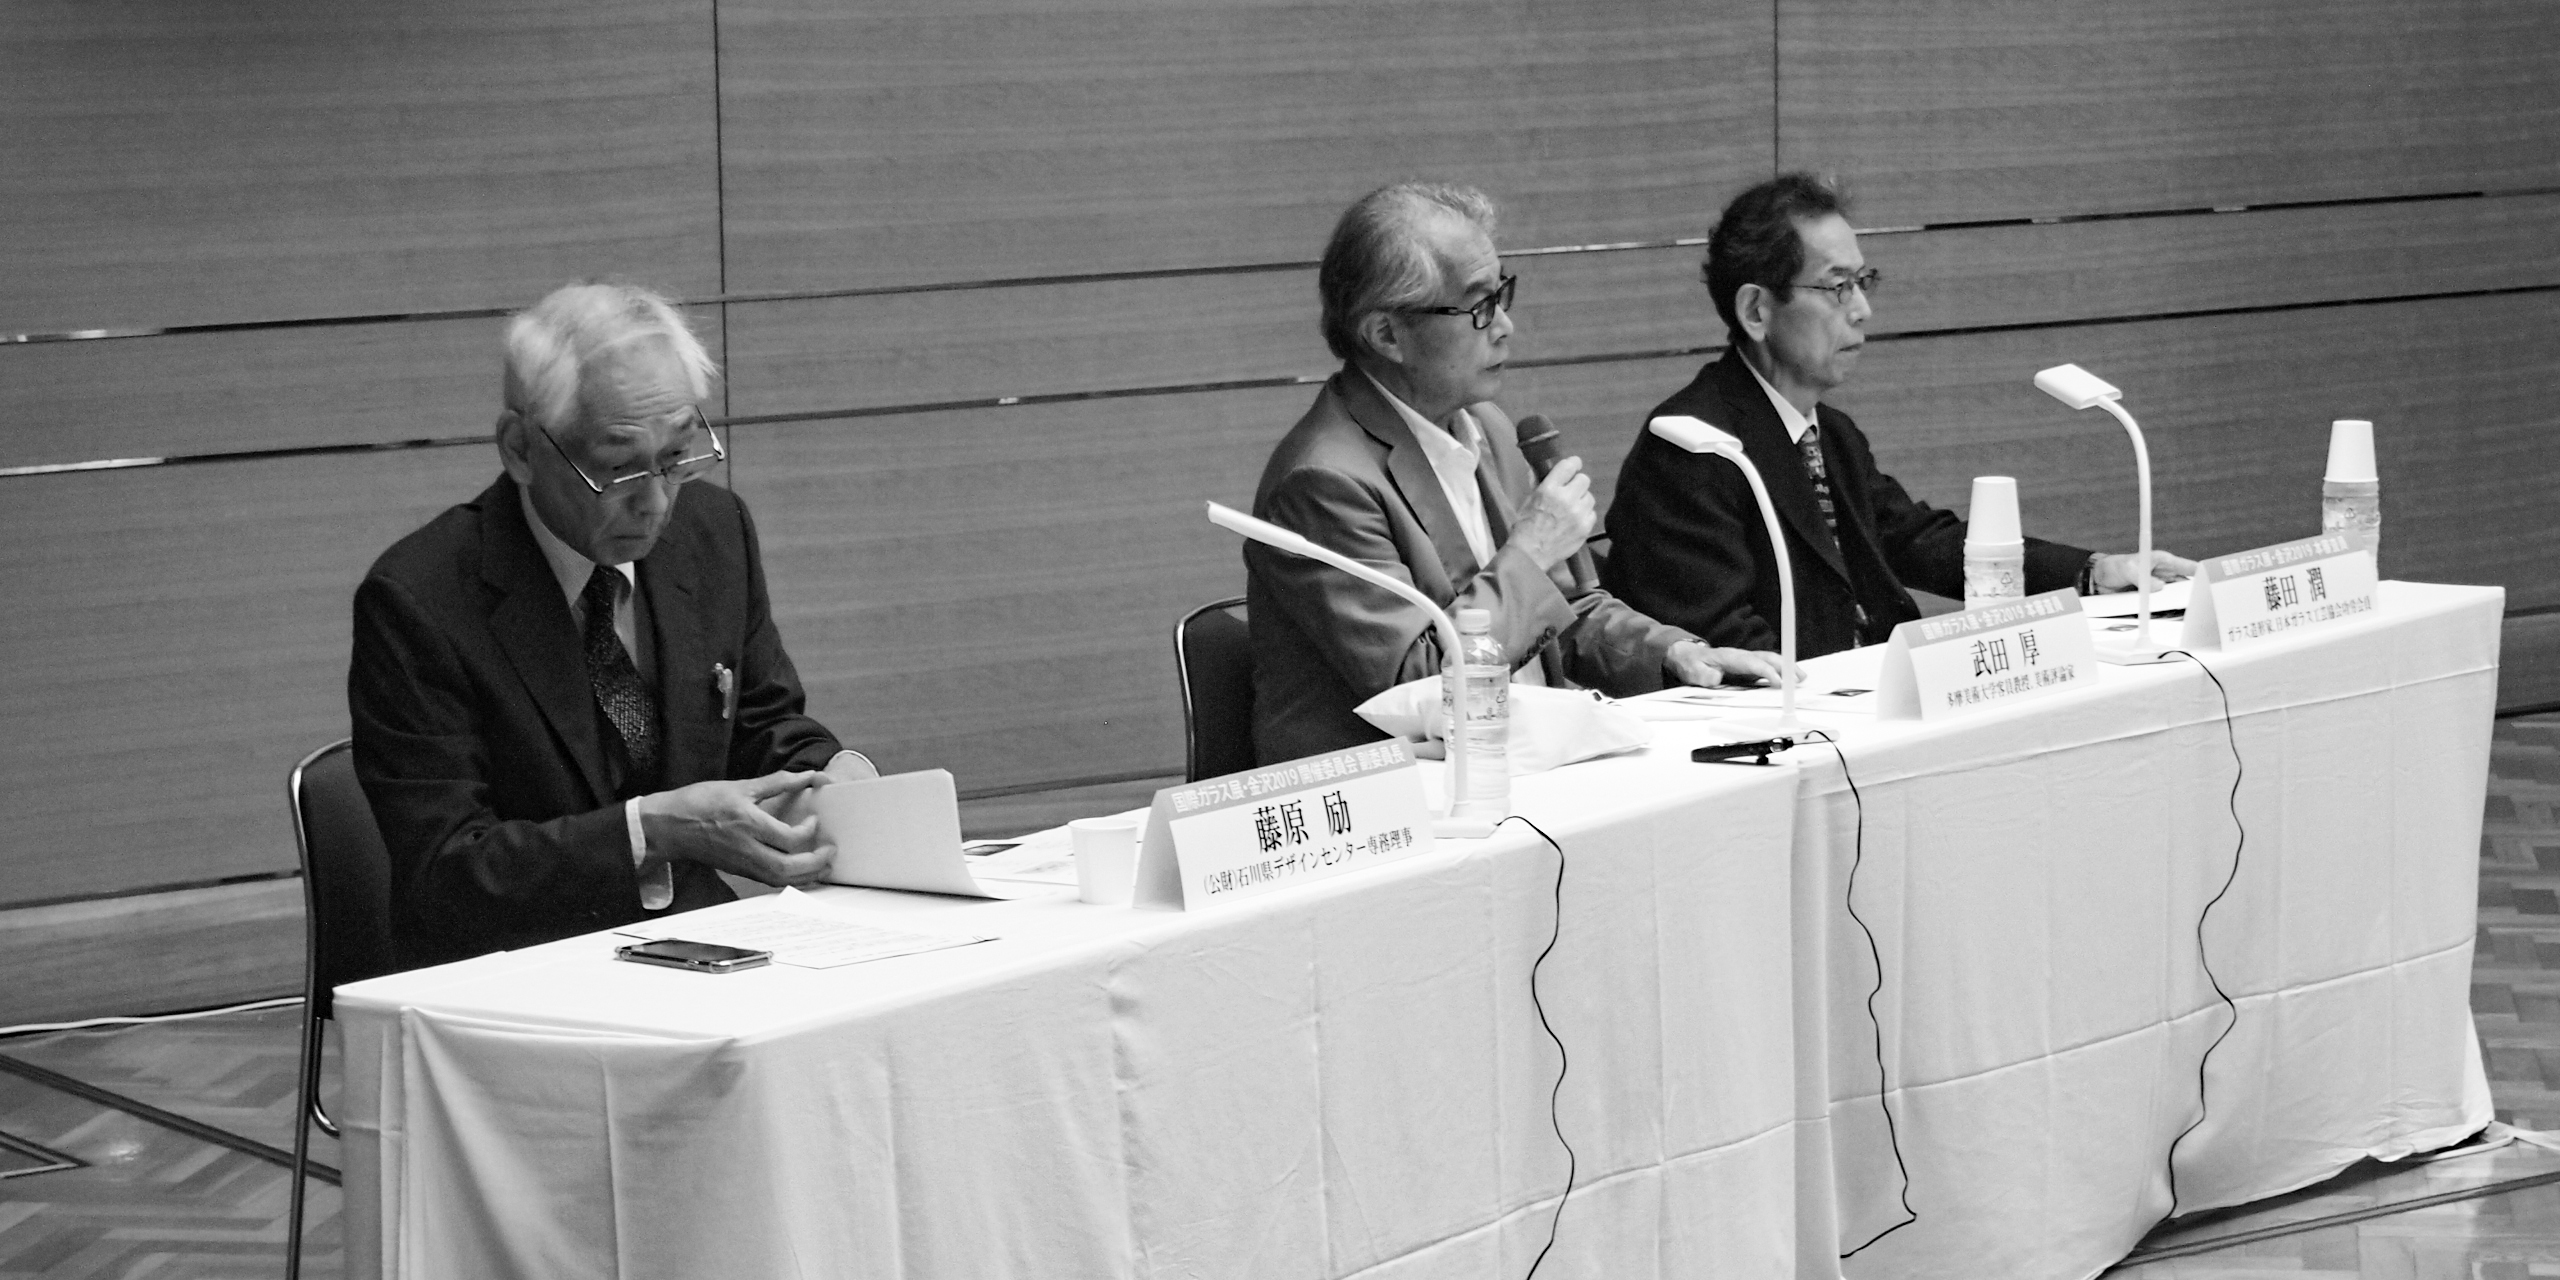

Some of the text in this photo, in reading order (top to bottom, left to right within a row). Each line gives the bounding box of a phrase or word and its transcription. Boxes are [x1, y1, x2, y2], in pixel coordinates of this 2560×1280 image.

[2262, 575, 2299, 611] 藤田
[1970, 629, 2040, 677] 武田 厚
[1170, 743, 1407, 814] 国際ガラス展・金沢2019 開催委員会 副委員長
[1252, 790, 1351, 853] 藤原 励
